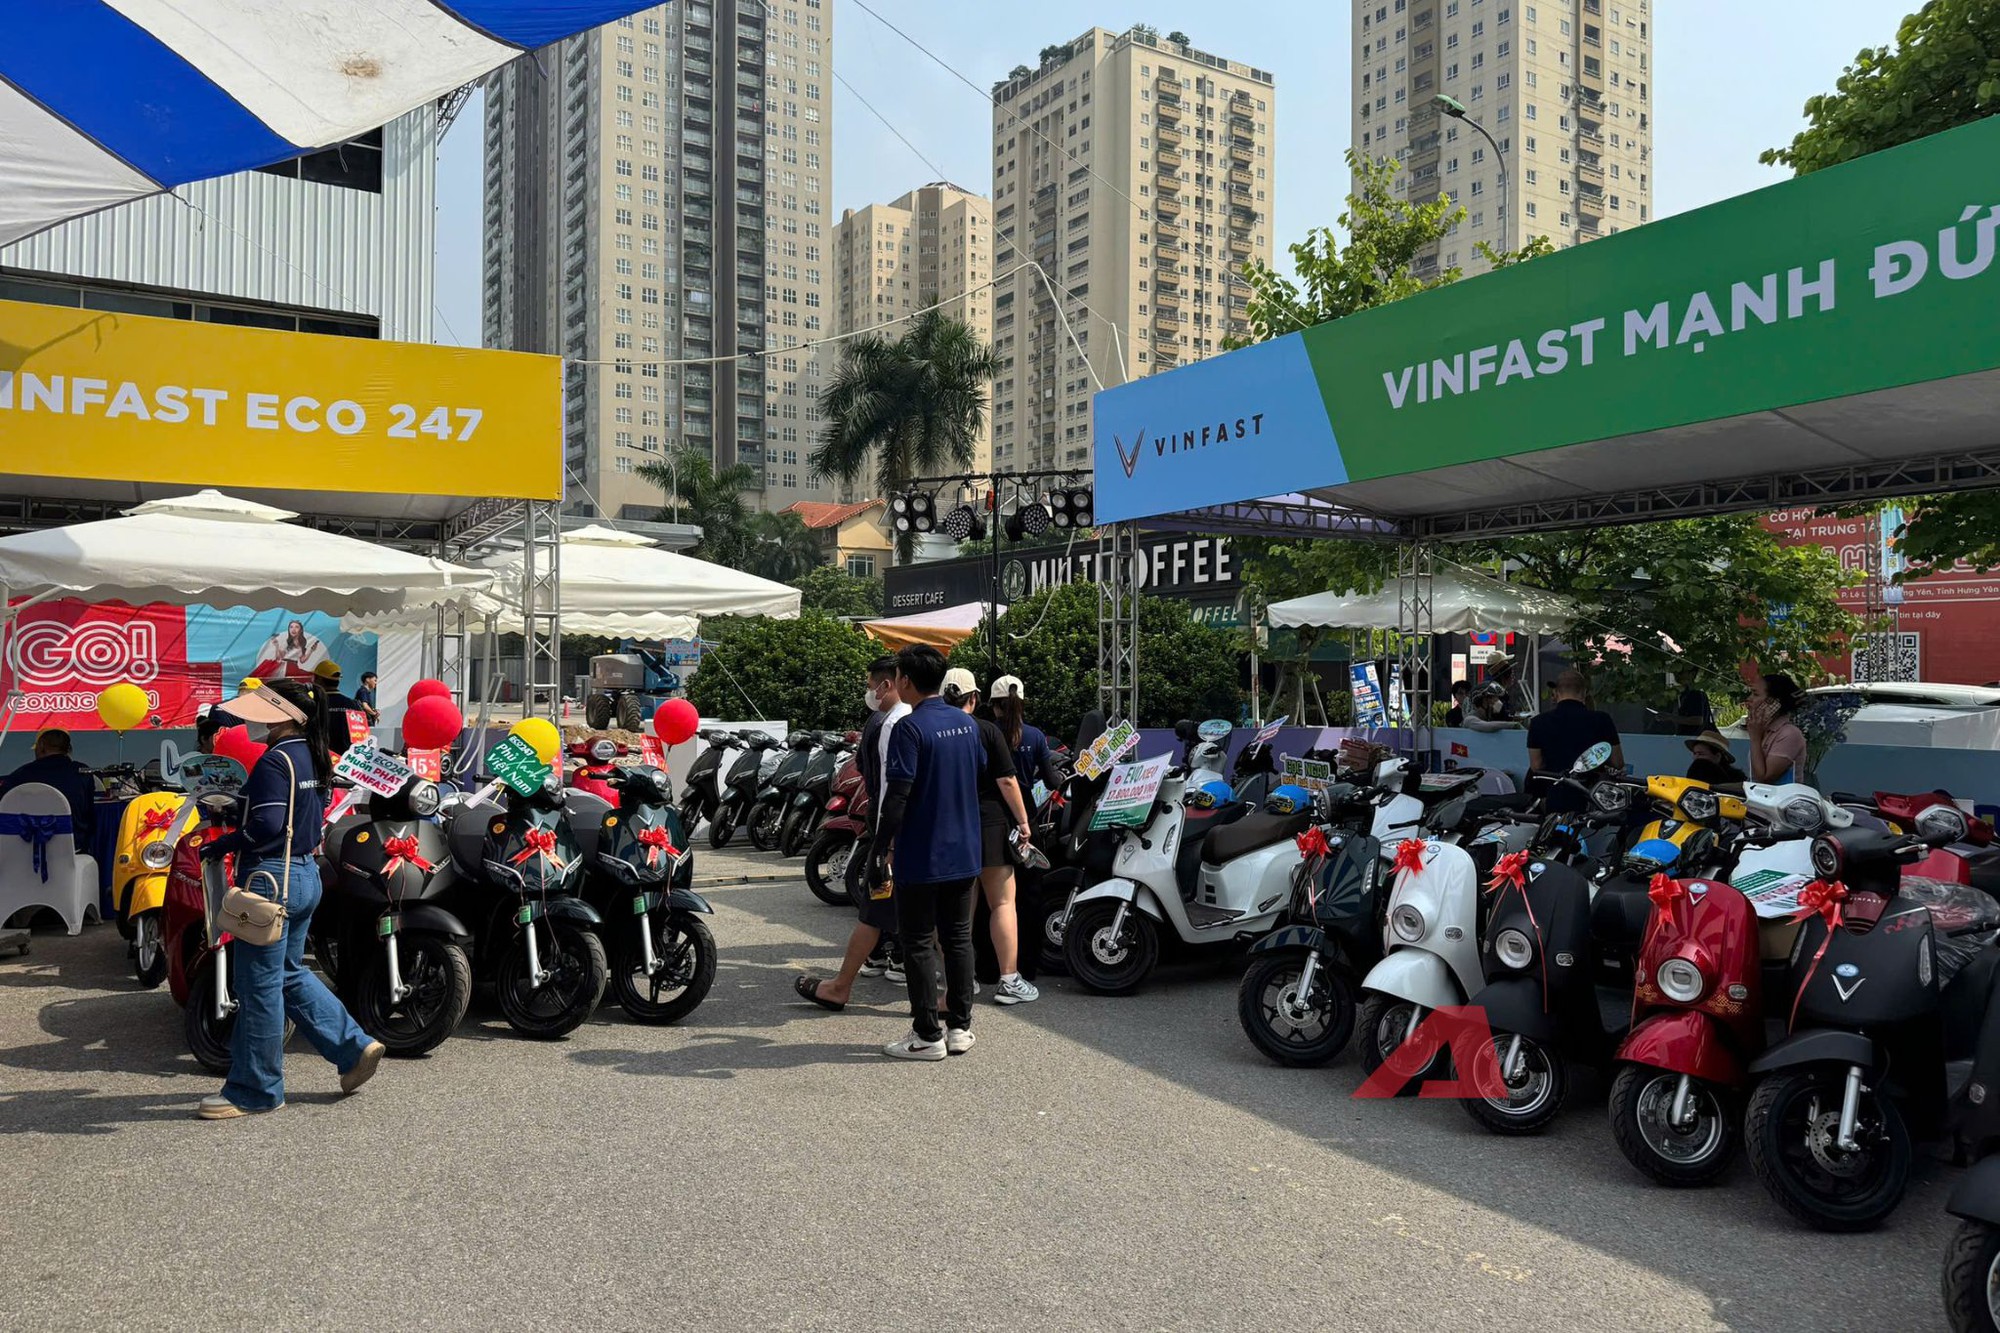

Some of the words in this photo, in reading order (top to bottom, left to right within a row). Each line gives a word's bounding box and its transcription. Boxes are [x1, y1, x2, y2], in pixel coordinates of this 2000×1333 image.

[1382, 317, 1605, 410] VINFAST
[1623, 258, 1835, 354] MẠNH
[0, 371, 228, 426] INFAST
[246, 393, 366, 435] ECO
[387, 404, 483, 441] 247
[1154, 413, 1264, 457] VINFAST
[1810, 523, 1857, 537] TRUNG
[892, 593, 924, 608] DESSERT
[925, 592, 944, 605] CAFE
[1187, 605, 1238, 623] OFFEE
[8, 621, 158, 685] GO!
[8, 690, 95, 712] COMING
[936, 725, 973, 739] VINFAST
[344, 753, 373, 773] Muốn
[373, 756, 410, 777] ECO247
[350, 769, 396, 796] VINFAST
[506, 771, 532, 794] Nam
